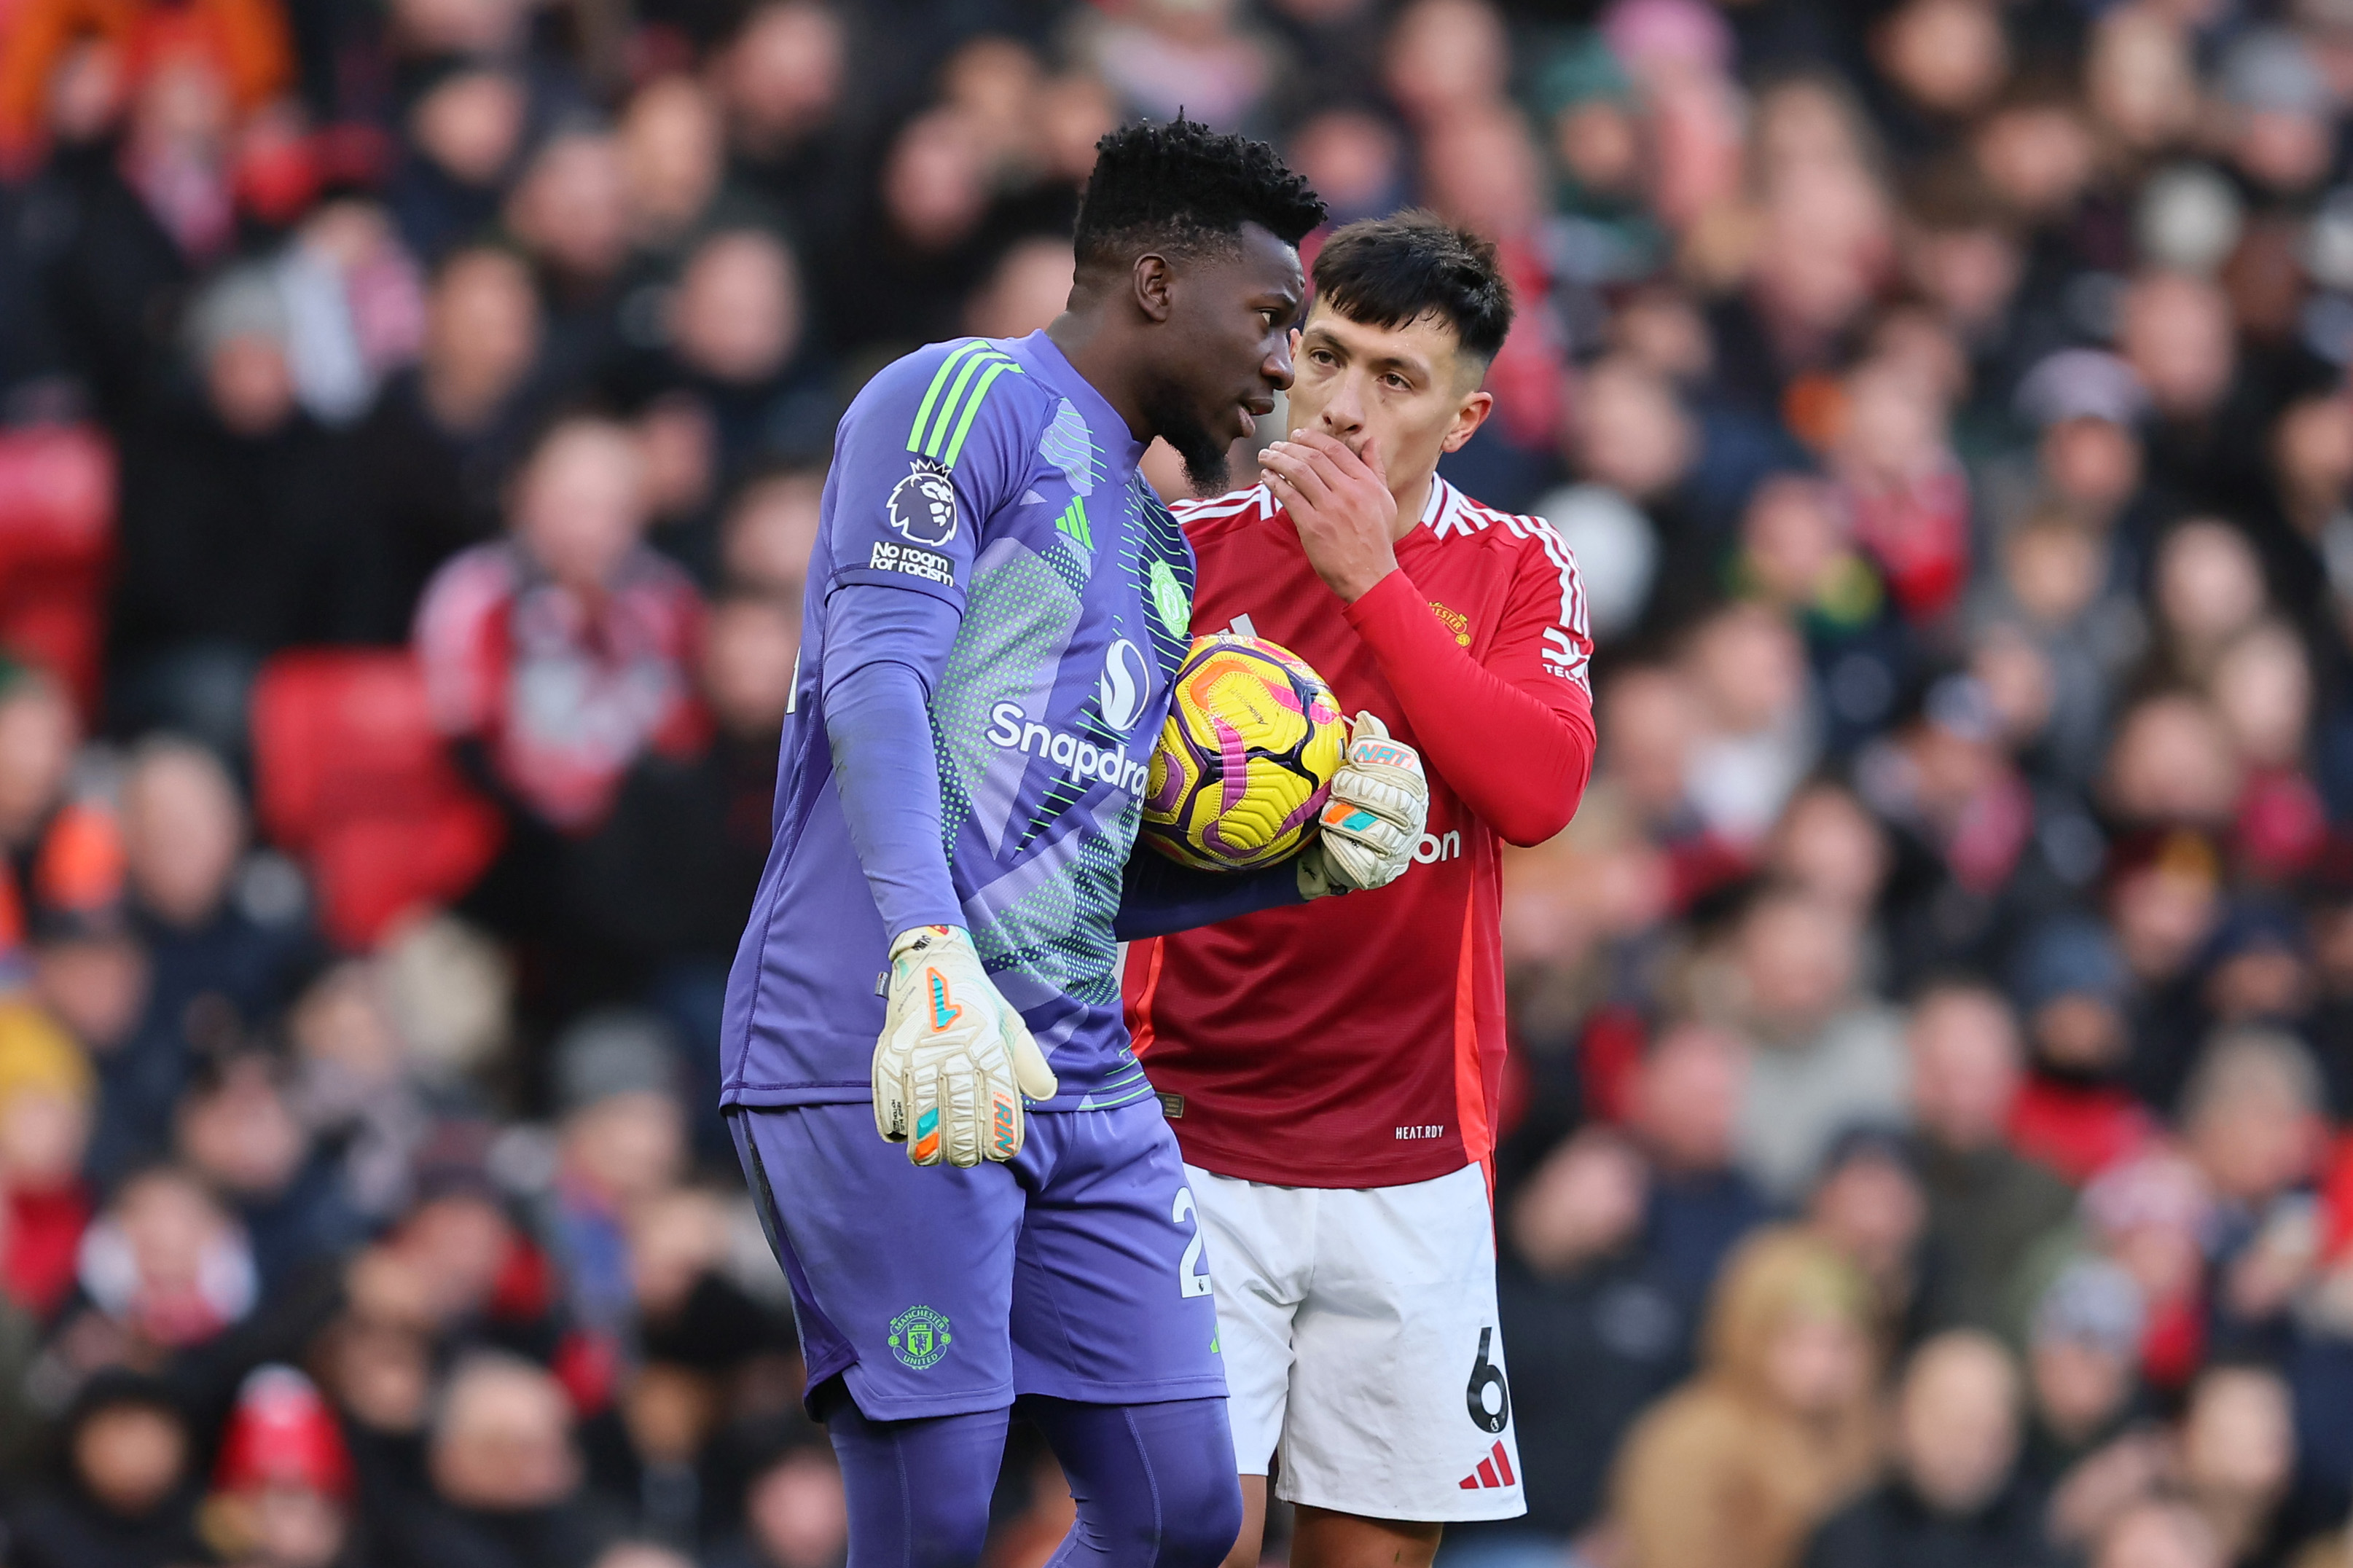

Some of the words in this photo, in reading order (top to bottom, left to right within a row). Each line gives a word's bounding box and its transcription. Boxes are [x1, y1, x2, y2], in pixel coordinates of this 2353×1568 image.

[872, 541, 900, 558] No
[901, 547, 948, 572] room
[898, 560, 954, 587] racism
[1395, 1125, 1444, 1140] HEAT.RDY
[1172, 1185, 1213, 1298] 2
[894, 1309, 945, 1331] MANCHESTER
[903, 1353, 938, 1365] UNITED
[1466, 1326, 1509, 1433] 6
